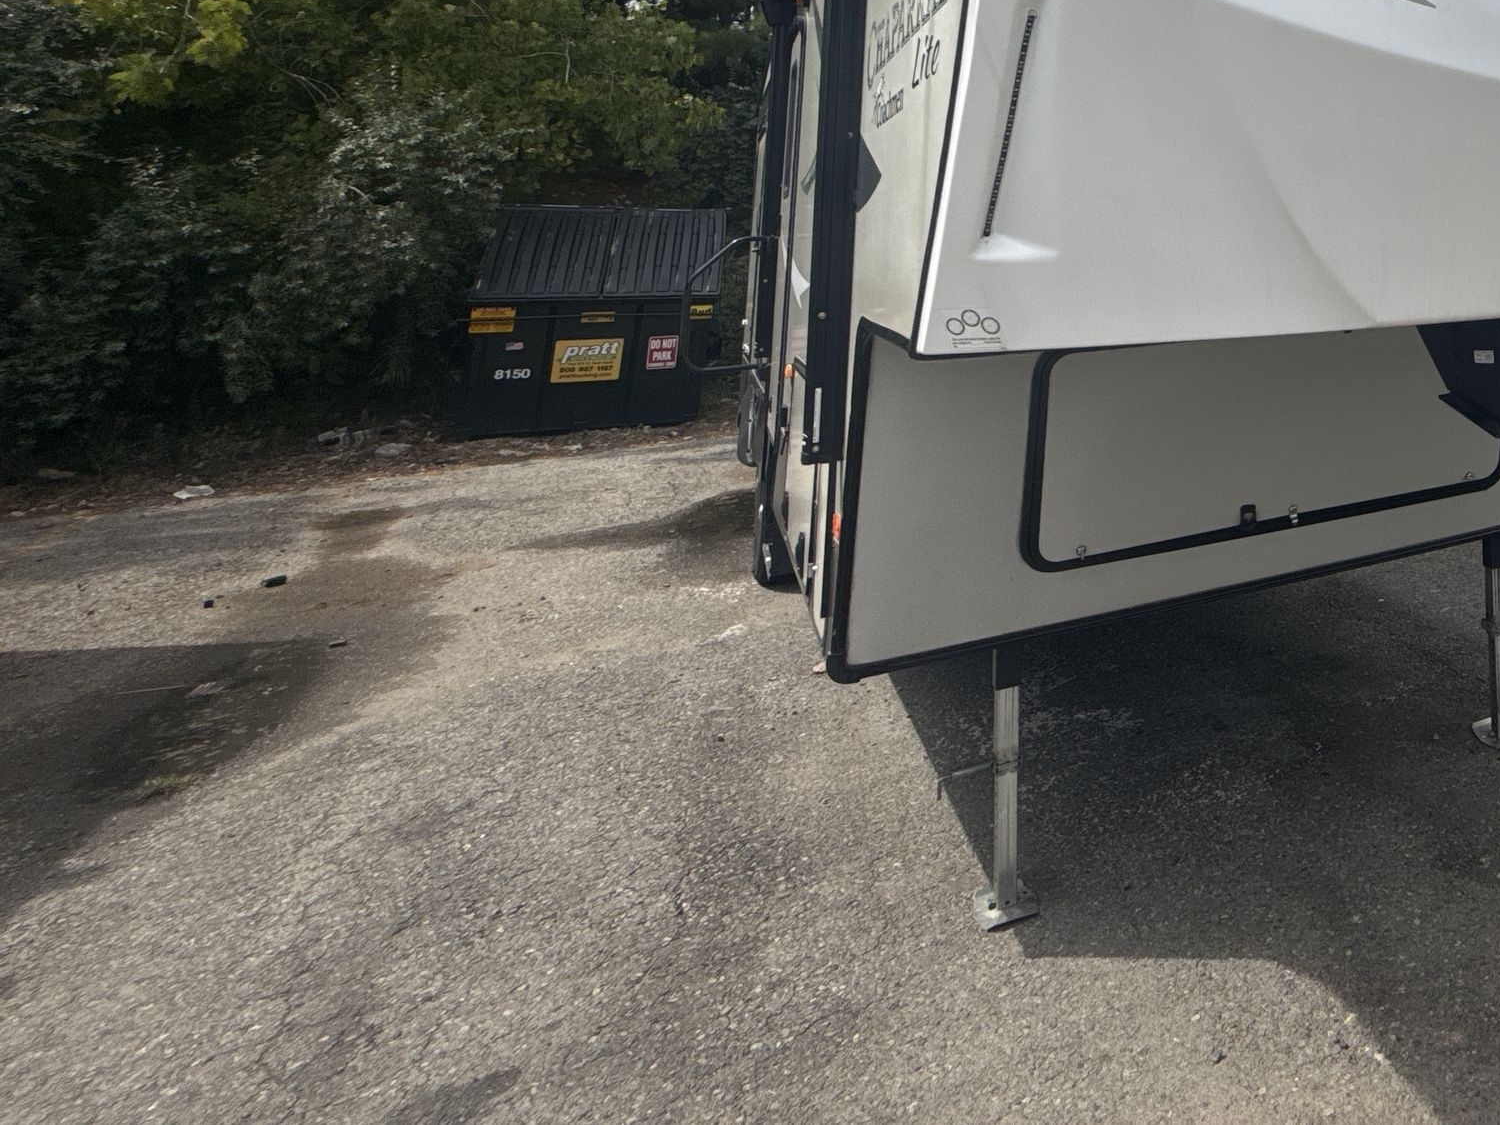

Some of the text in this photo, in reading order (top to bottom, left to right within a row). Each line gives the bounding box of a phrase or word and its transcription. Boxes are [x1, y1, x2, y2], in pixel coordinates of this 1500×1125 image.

[911, 34, 941, 89] Lite
[650, 338, 677, 350] DO NOT
[560, 341, 620, 364] pratt
[652, 350, 672, 362] PARK
[493, 368, 531, 380] 8150
